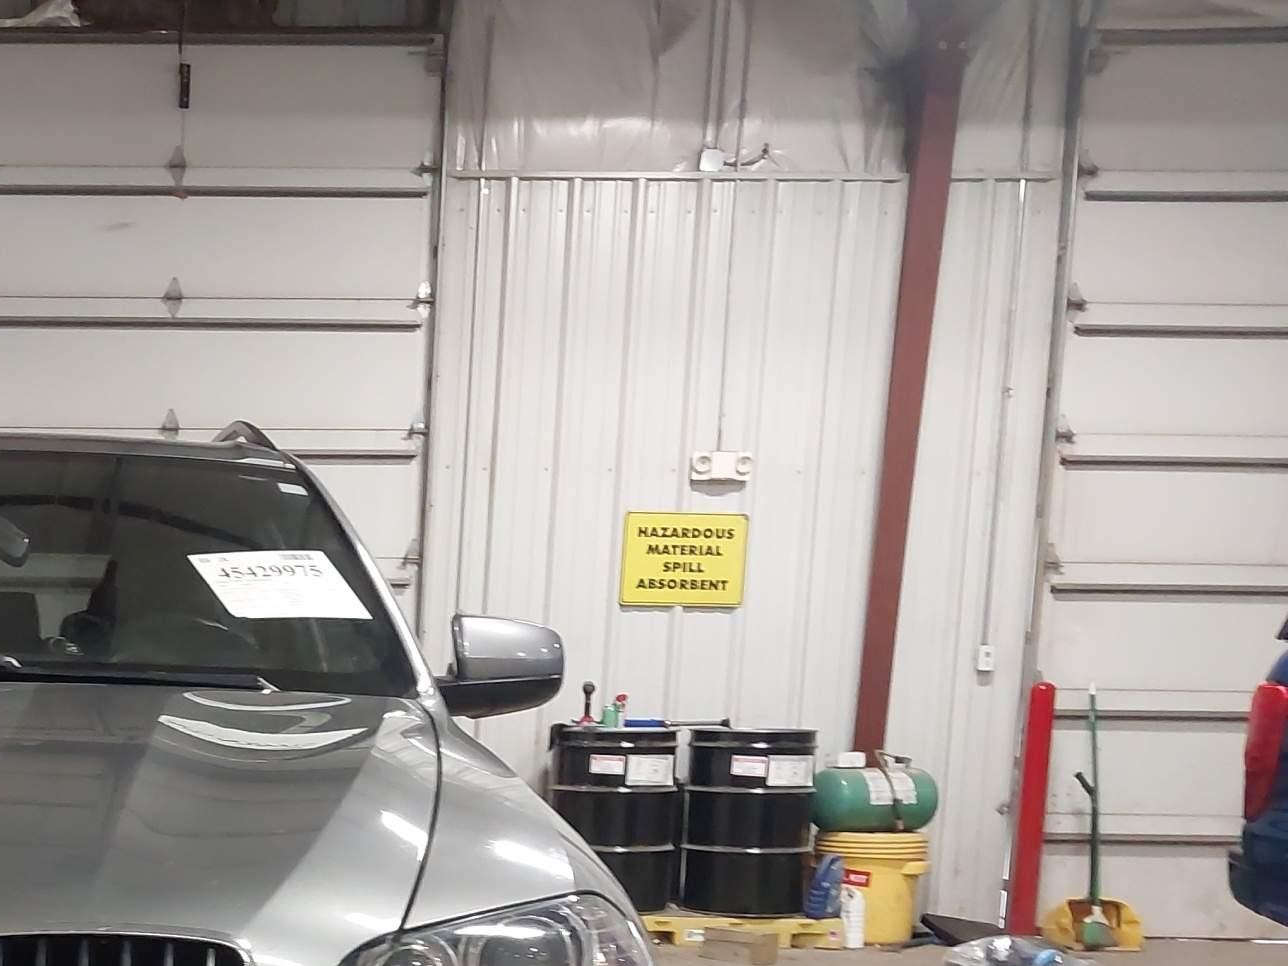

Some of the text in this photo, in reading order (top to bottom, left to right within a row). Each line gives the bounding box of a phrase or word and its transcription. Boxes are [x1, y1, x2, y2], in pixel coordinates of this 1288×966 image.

[638, 526, 735, 540] HAZARDOUS
[646, 544, 723, 556] MATERIAL
[217, 564, 324, 579] 45429975
[662, 561, 705, 573] SPILL
[636, 578, 729, 591] ABSORBENT
